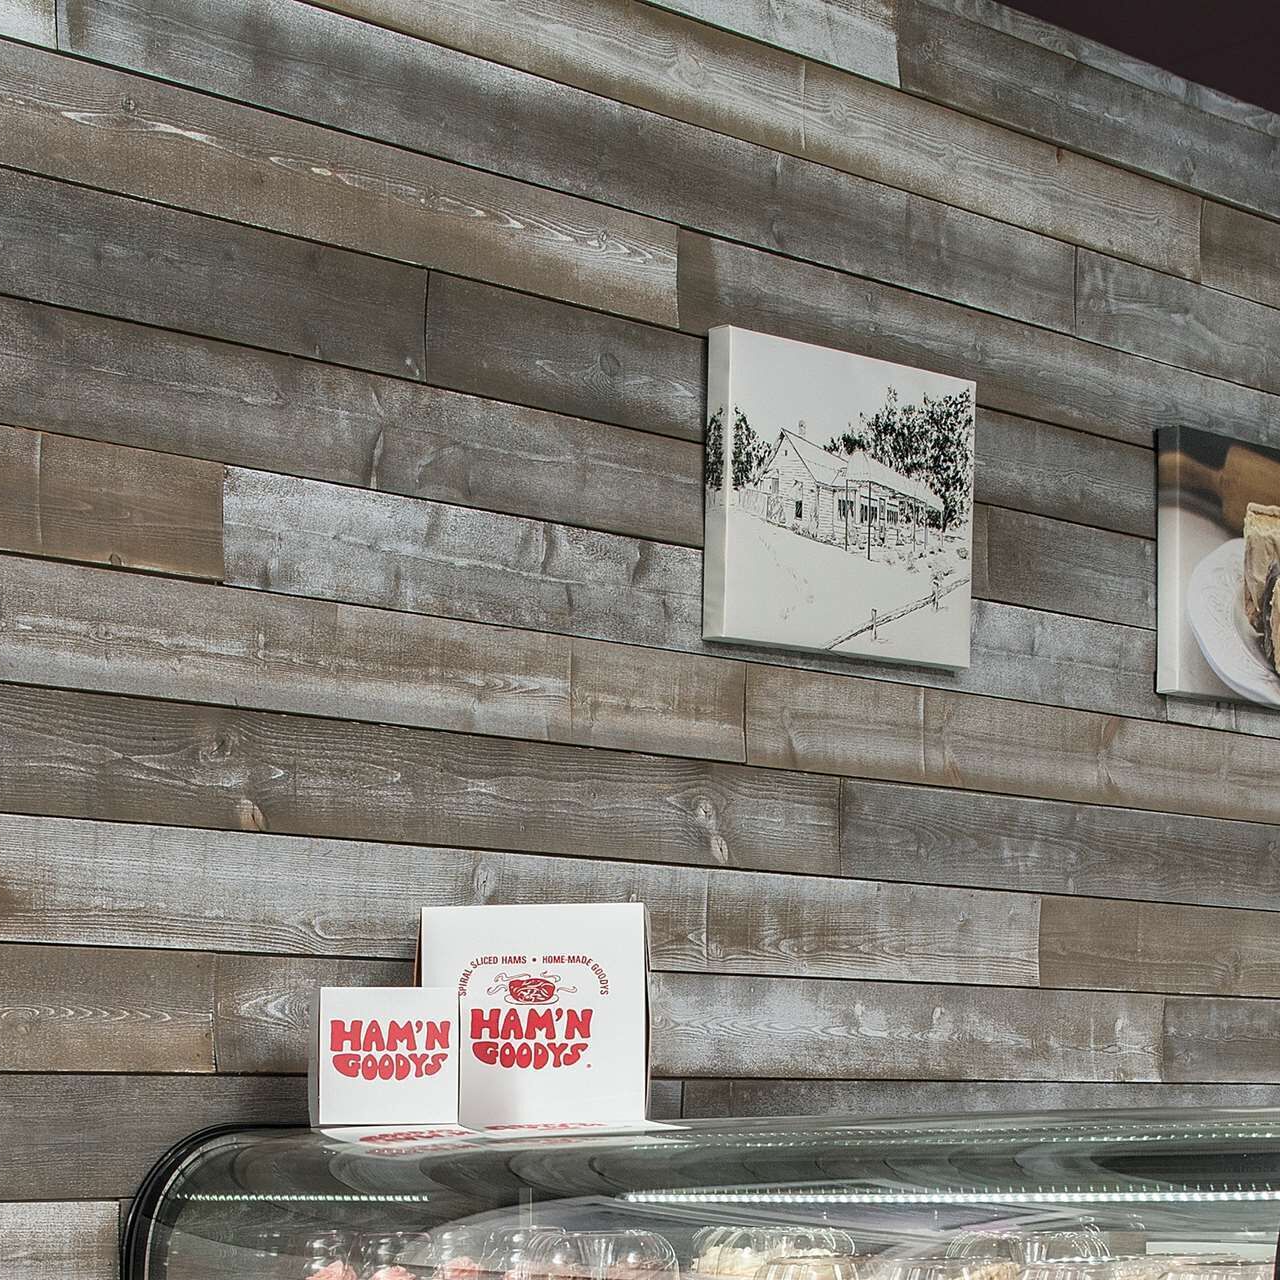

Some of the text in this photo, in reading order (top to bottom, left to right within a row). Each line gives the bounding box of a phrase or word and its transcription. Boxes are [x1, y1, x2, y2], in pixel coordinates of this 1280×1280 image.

[458, 955, 609, 997] SPIRAL SLICED HAMS HOME-MADE GOODYS
[329, 1019, 451, 1053] HAM'N
[469, 1008, 594, 1040] HAM'N
[331, 1053, 449, 1081] GOODYS
[471, 1041, 589, 1070] GOODYS
